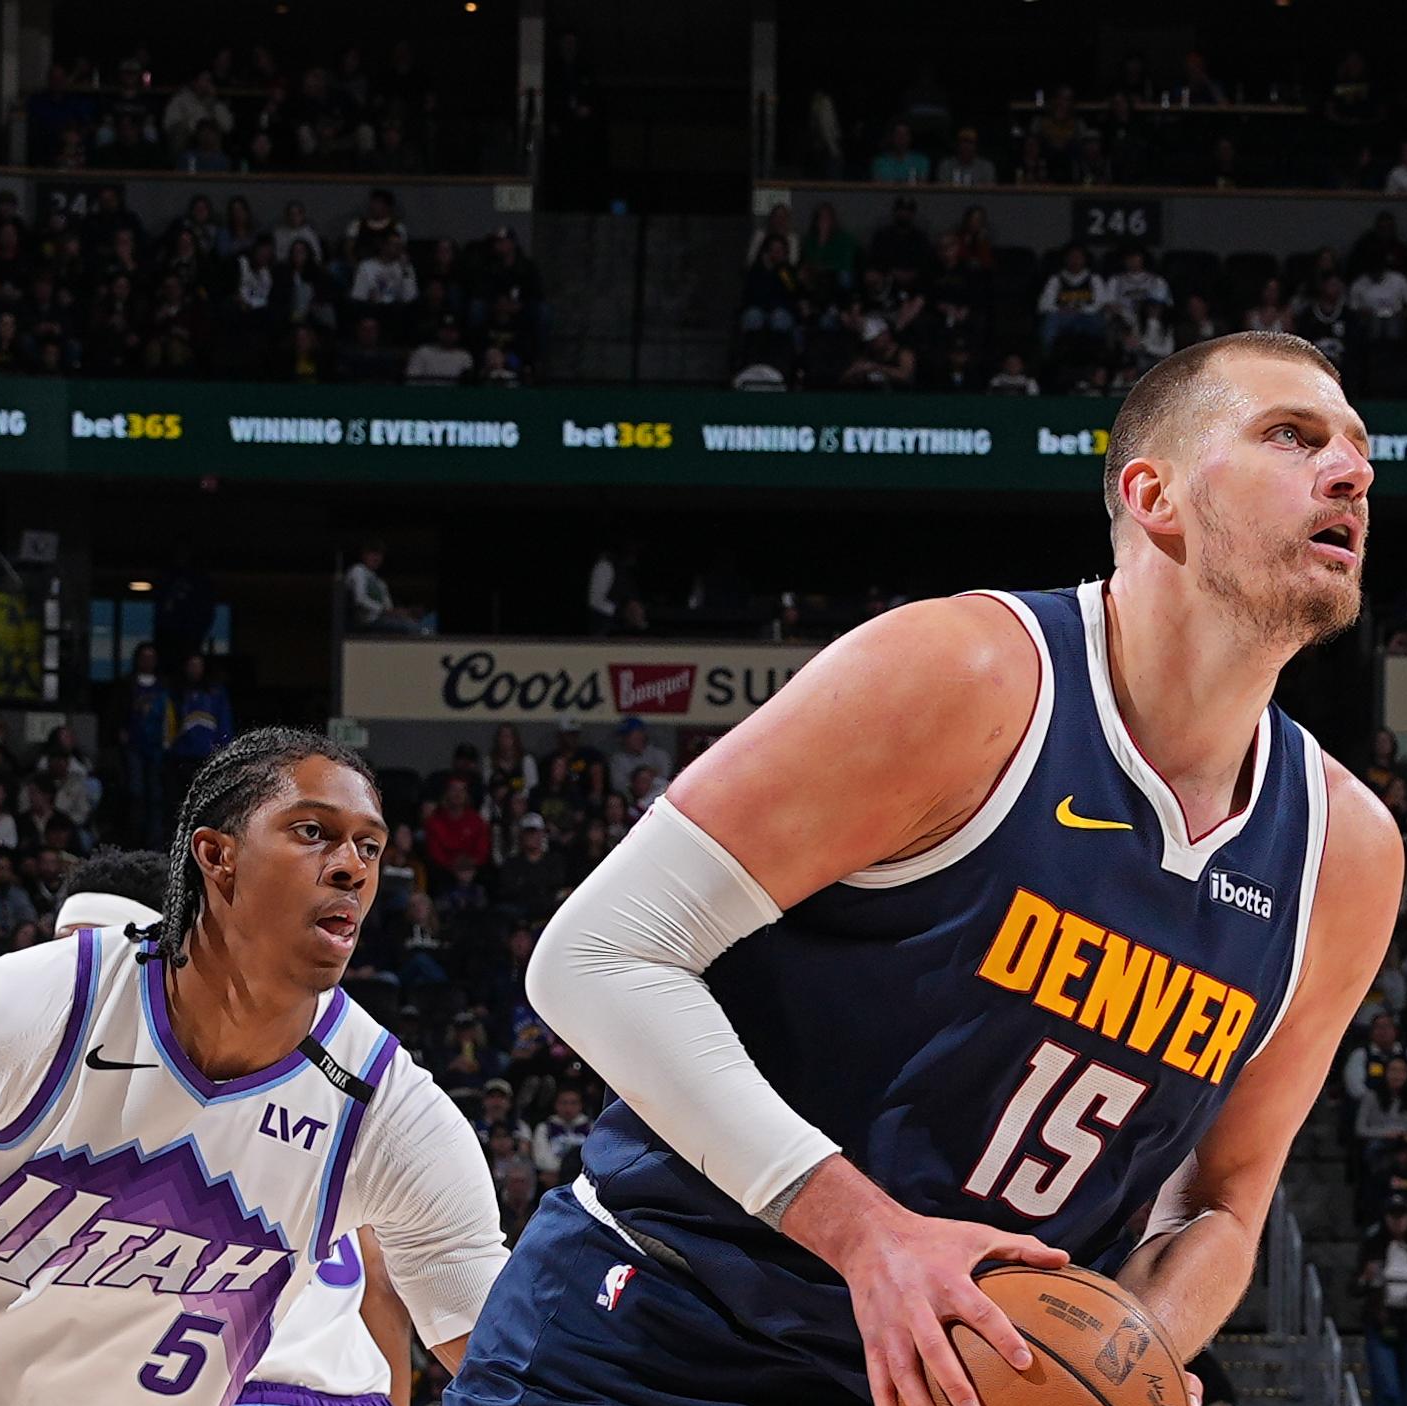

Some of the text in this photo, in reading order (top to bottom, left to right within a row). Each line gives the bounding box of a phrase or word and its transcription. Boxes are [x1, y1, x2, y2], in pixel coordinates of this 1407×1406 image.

[1088, 208, 1146, 236] 246
[72, 411, 181, 438] bet365
[230, 417, 342, 444] WINNING
[370, 420, 519, 447] EVERYTHING
[563, 421, 671, 447] bet365
[703, 426, 815, 452] WINNING
[843, 427, 991, 454] EVERYTHING
[1038, 427, 1110, 455] bet3
[440, 651, 605, 712] Coors
[706, 666, 793, 706] SU
[1210, 872, 1273, 920] ibotta
[975, 885, 1259, 1085] DENVER
[319, 1054, 352, 1089] FRANK
[259, 1102, 329, 1151] LVT
[961, 1037, 1151, 1221] 15
[137, 1310, 227, 1396] 5
